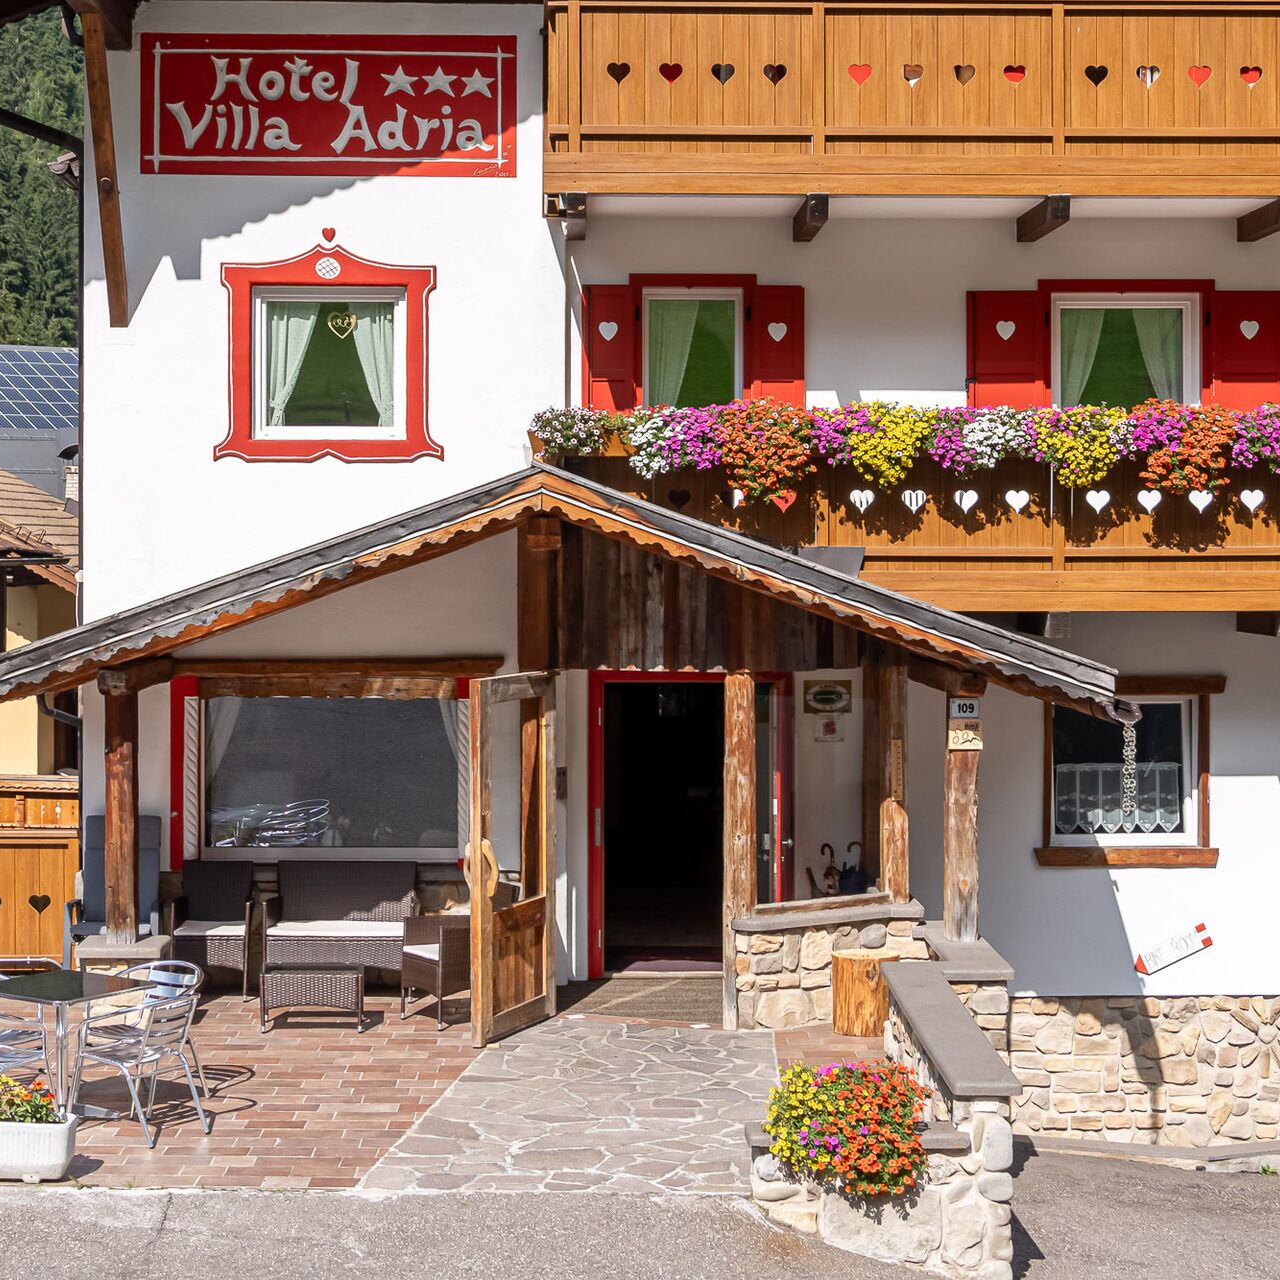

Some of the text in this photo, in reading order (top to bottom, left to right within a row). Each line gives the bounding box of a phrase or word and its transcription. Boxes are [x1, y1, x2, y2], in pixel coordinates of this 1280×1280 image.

[210, 55, 360, 103] Hotel
[166, 101, 495, 154] Villa Adria
[957, 703, 975, 714] 109
